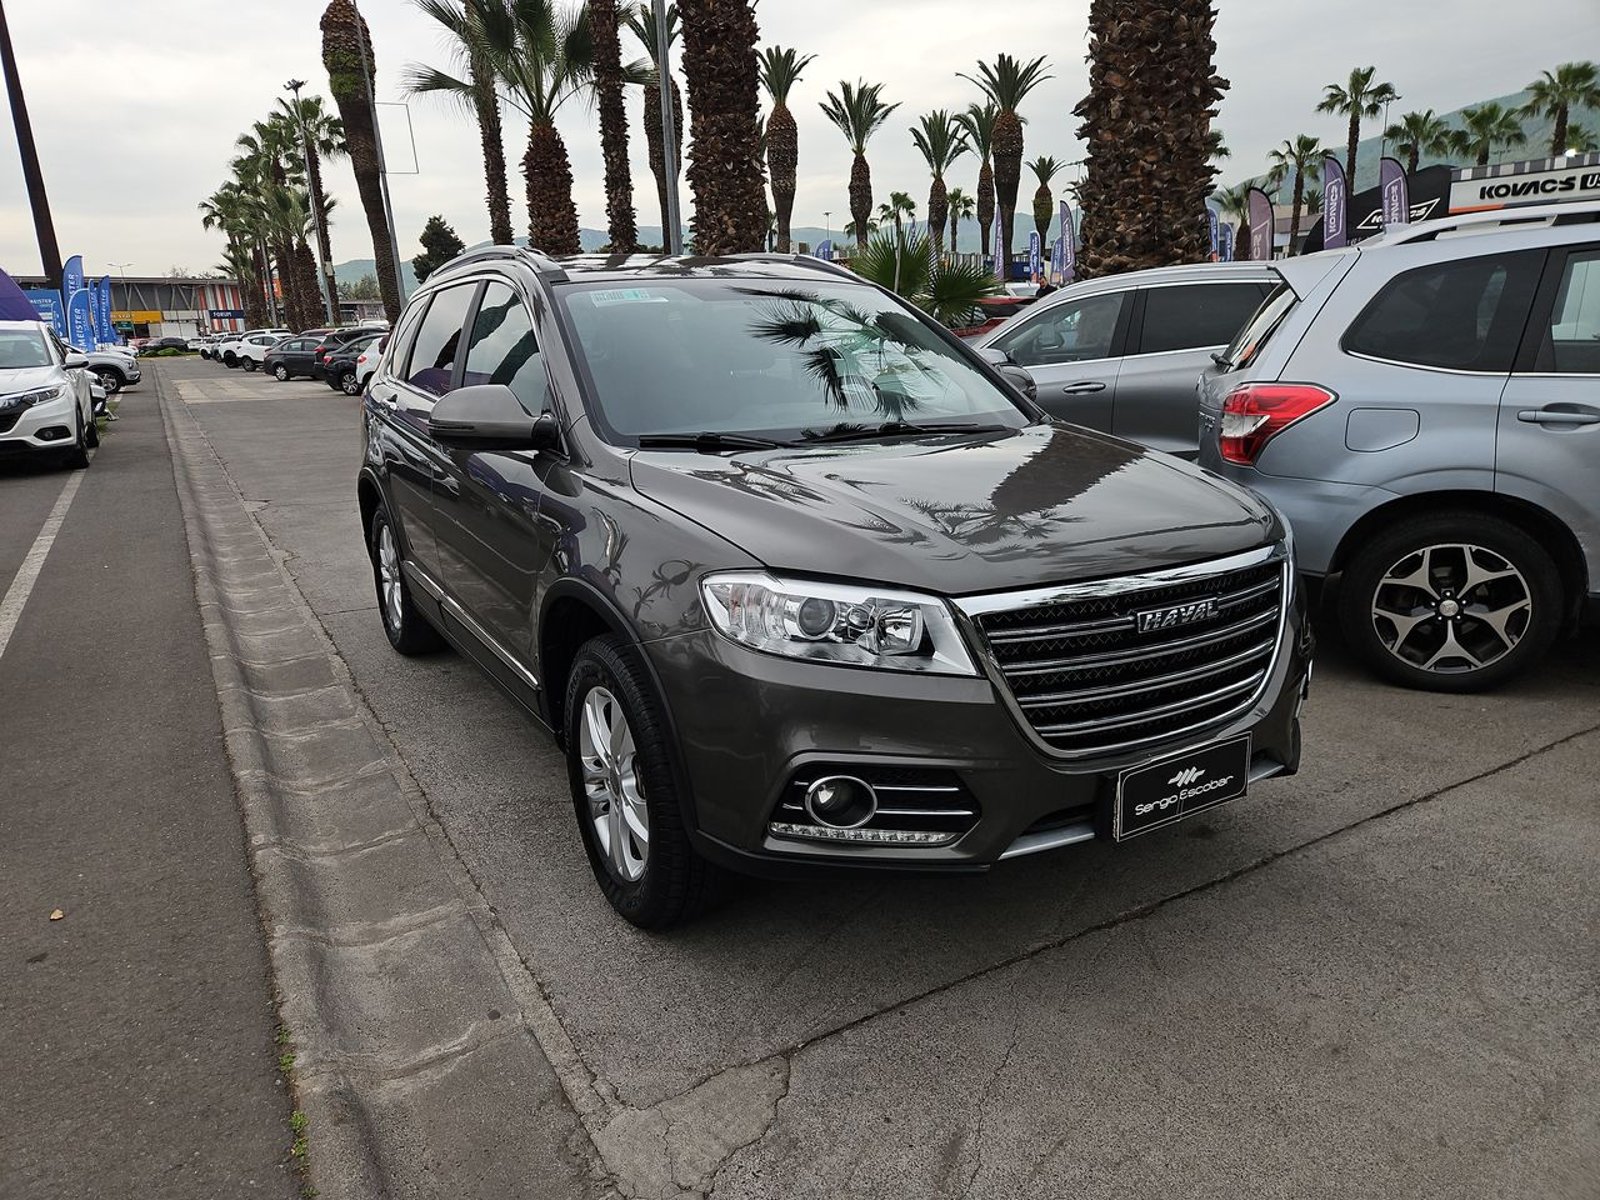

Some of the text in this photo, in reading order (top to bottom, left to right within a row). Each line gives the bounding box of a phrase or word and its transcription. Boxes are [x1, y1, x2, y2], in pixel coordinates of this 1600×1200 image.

[1480, 175, 1576, 200] KOVACS
[1329, 185, 1337, 233] KOVACS
[1143, 601, 1218, 631] HAVAL
[1180, 775, 1234, 800] Escobar
